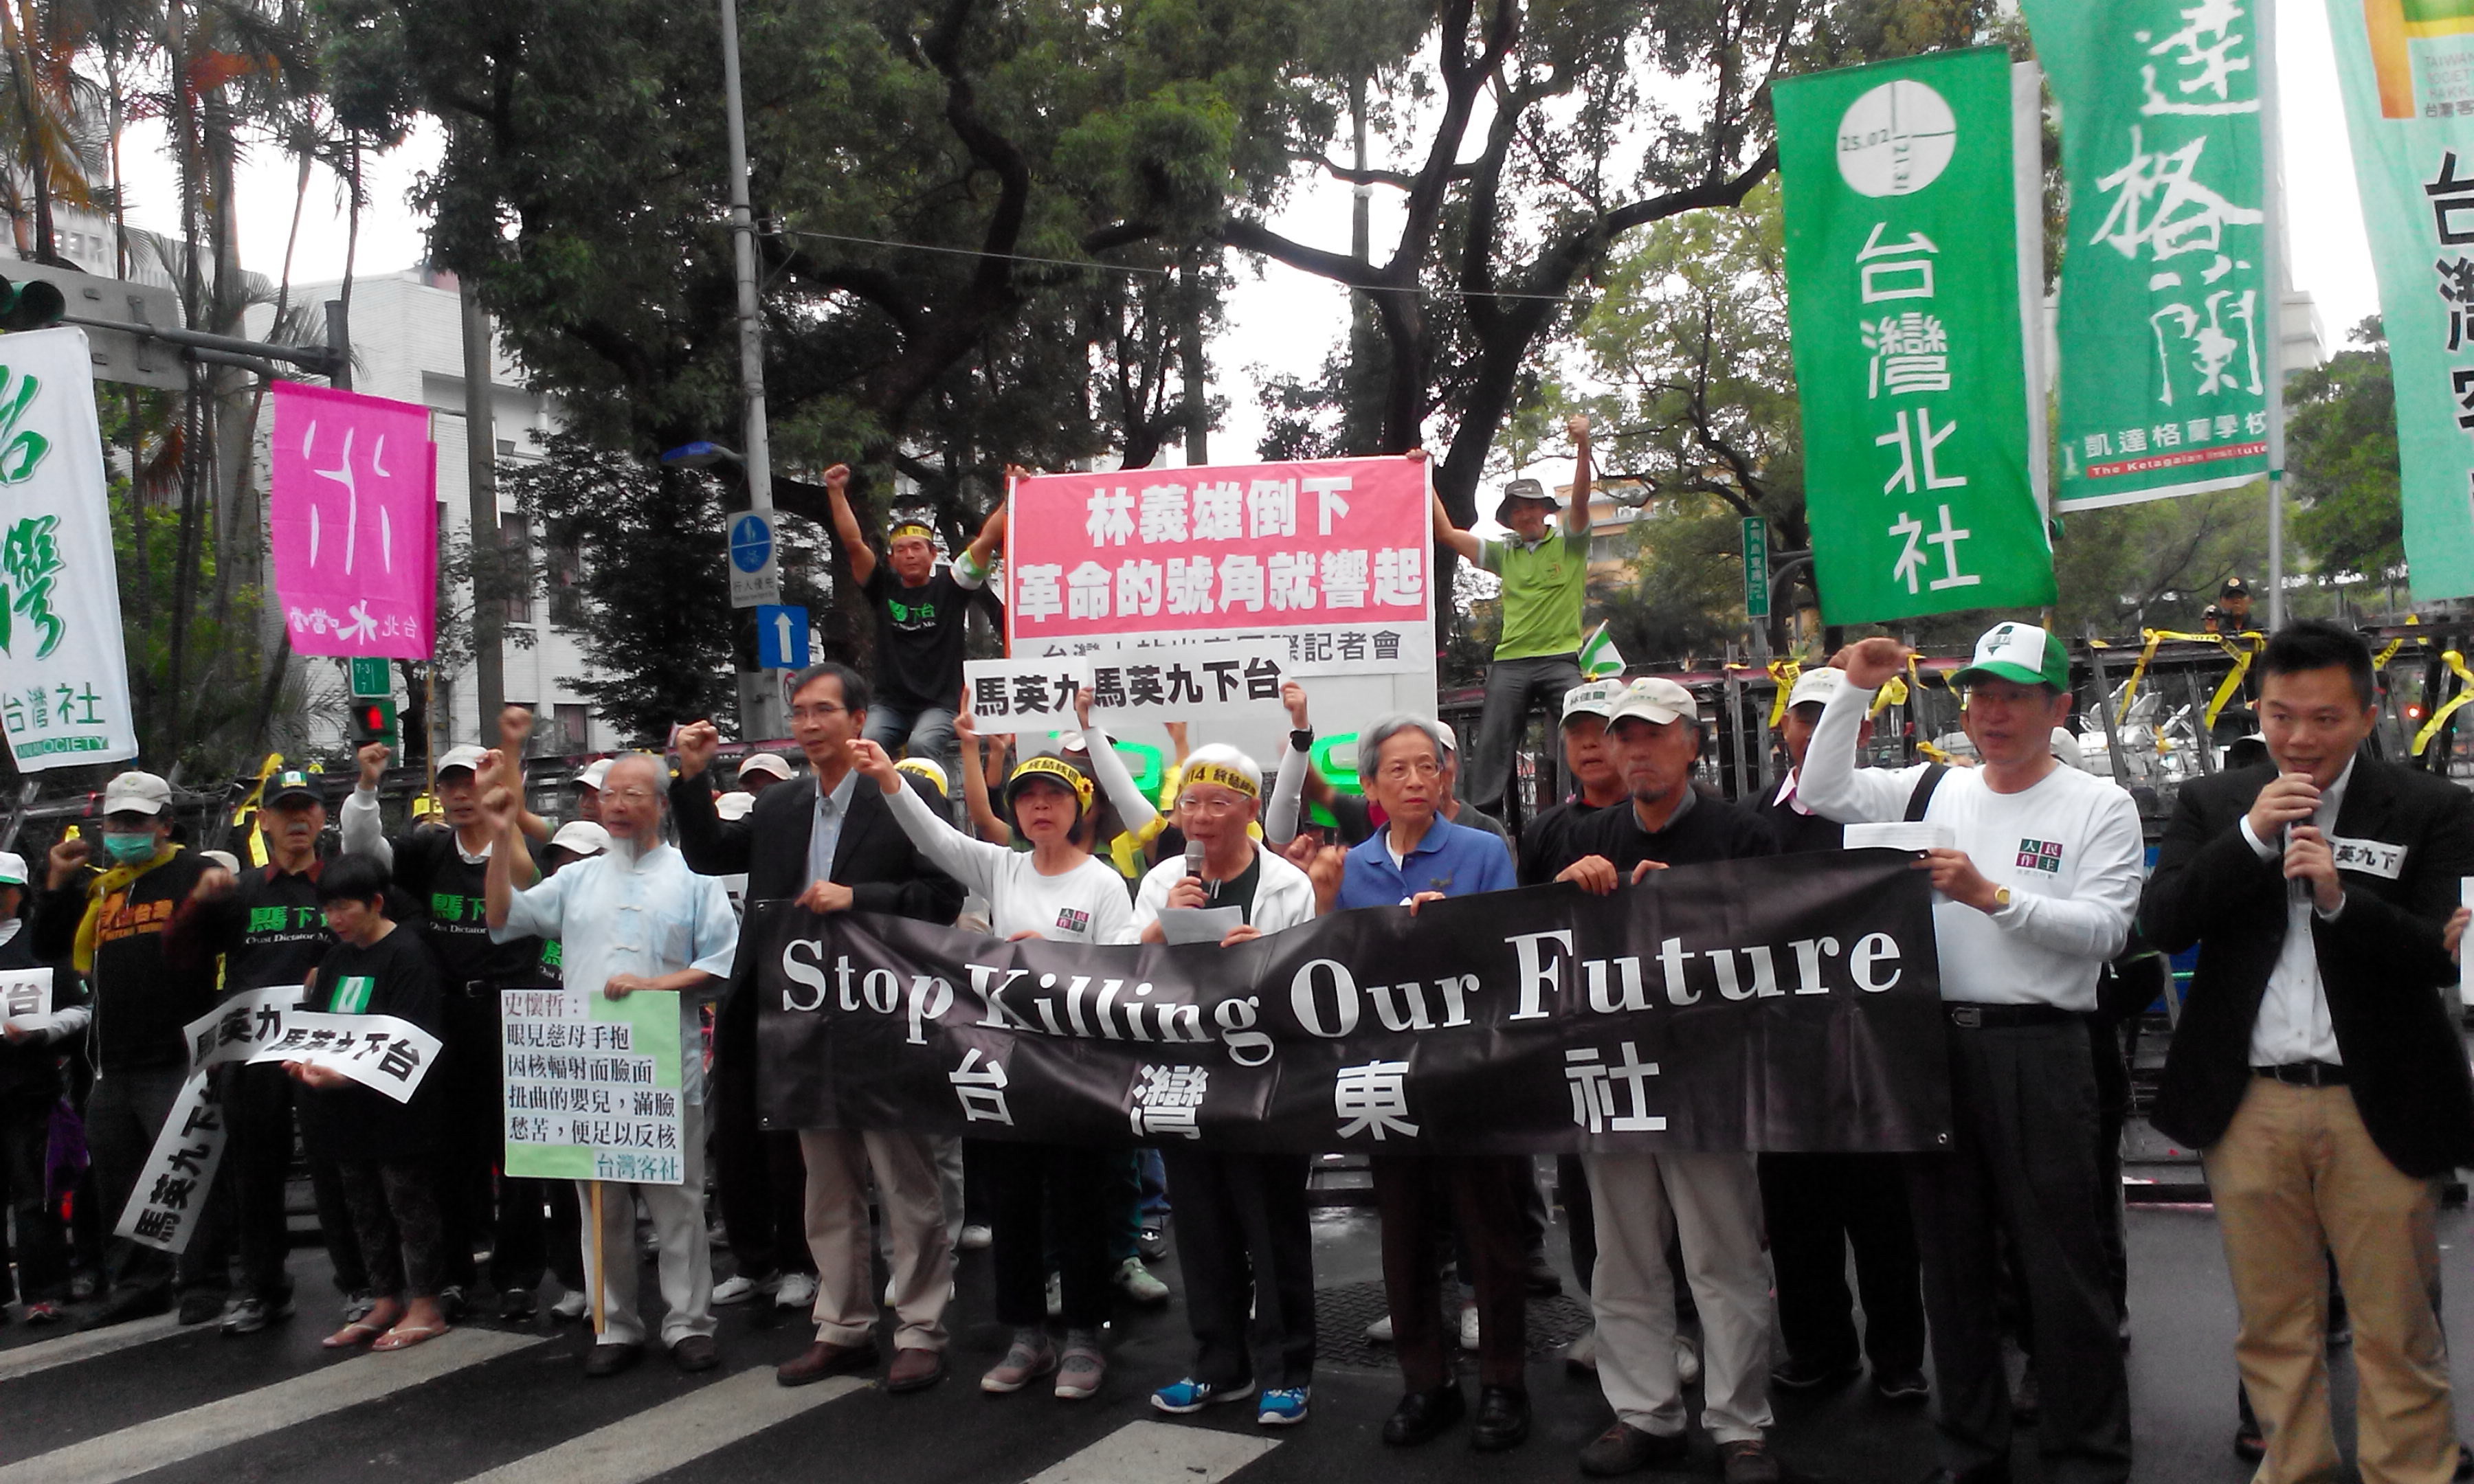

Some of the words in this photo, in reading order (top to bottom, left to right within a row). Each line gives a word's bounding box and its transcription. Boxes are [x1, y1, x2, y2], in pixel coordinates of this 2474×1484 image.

[1855, 223, 1981, 596] 台灣北社
[2093, 465, 2120, 476] The
[1086, 476, 1353, 548] 林義雄倒下
[1016, 547, 1425, 623] 革命的號角就響起
[3, 682, 105, 733] 台灣社
[1093, 657, 1282, 710] 馬英九下台
[43, 737, 109, 754] OCIETY
[2326, 840, 2398, 870] 英九下
[782, 938, 955, 1045] Stop
[964, 963, 1275, 1067] Killing
[1291, 958, 1480, 1039] Our
[1504, 929, 1902, 1022] Future
[506, 1024, 629, 1050] 眼見慈母手抱
[948, 1042, 1667, 1141] 台灣東社
[133, 1088, 221, 1244] 馬英九下
[597, 1153, 680, 1182] 台灣客社
